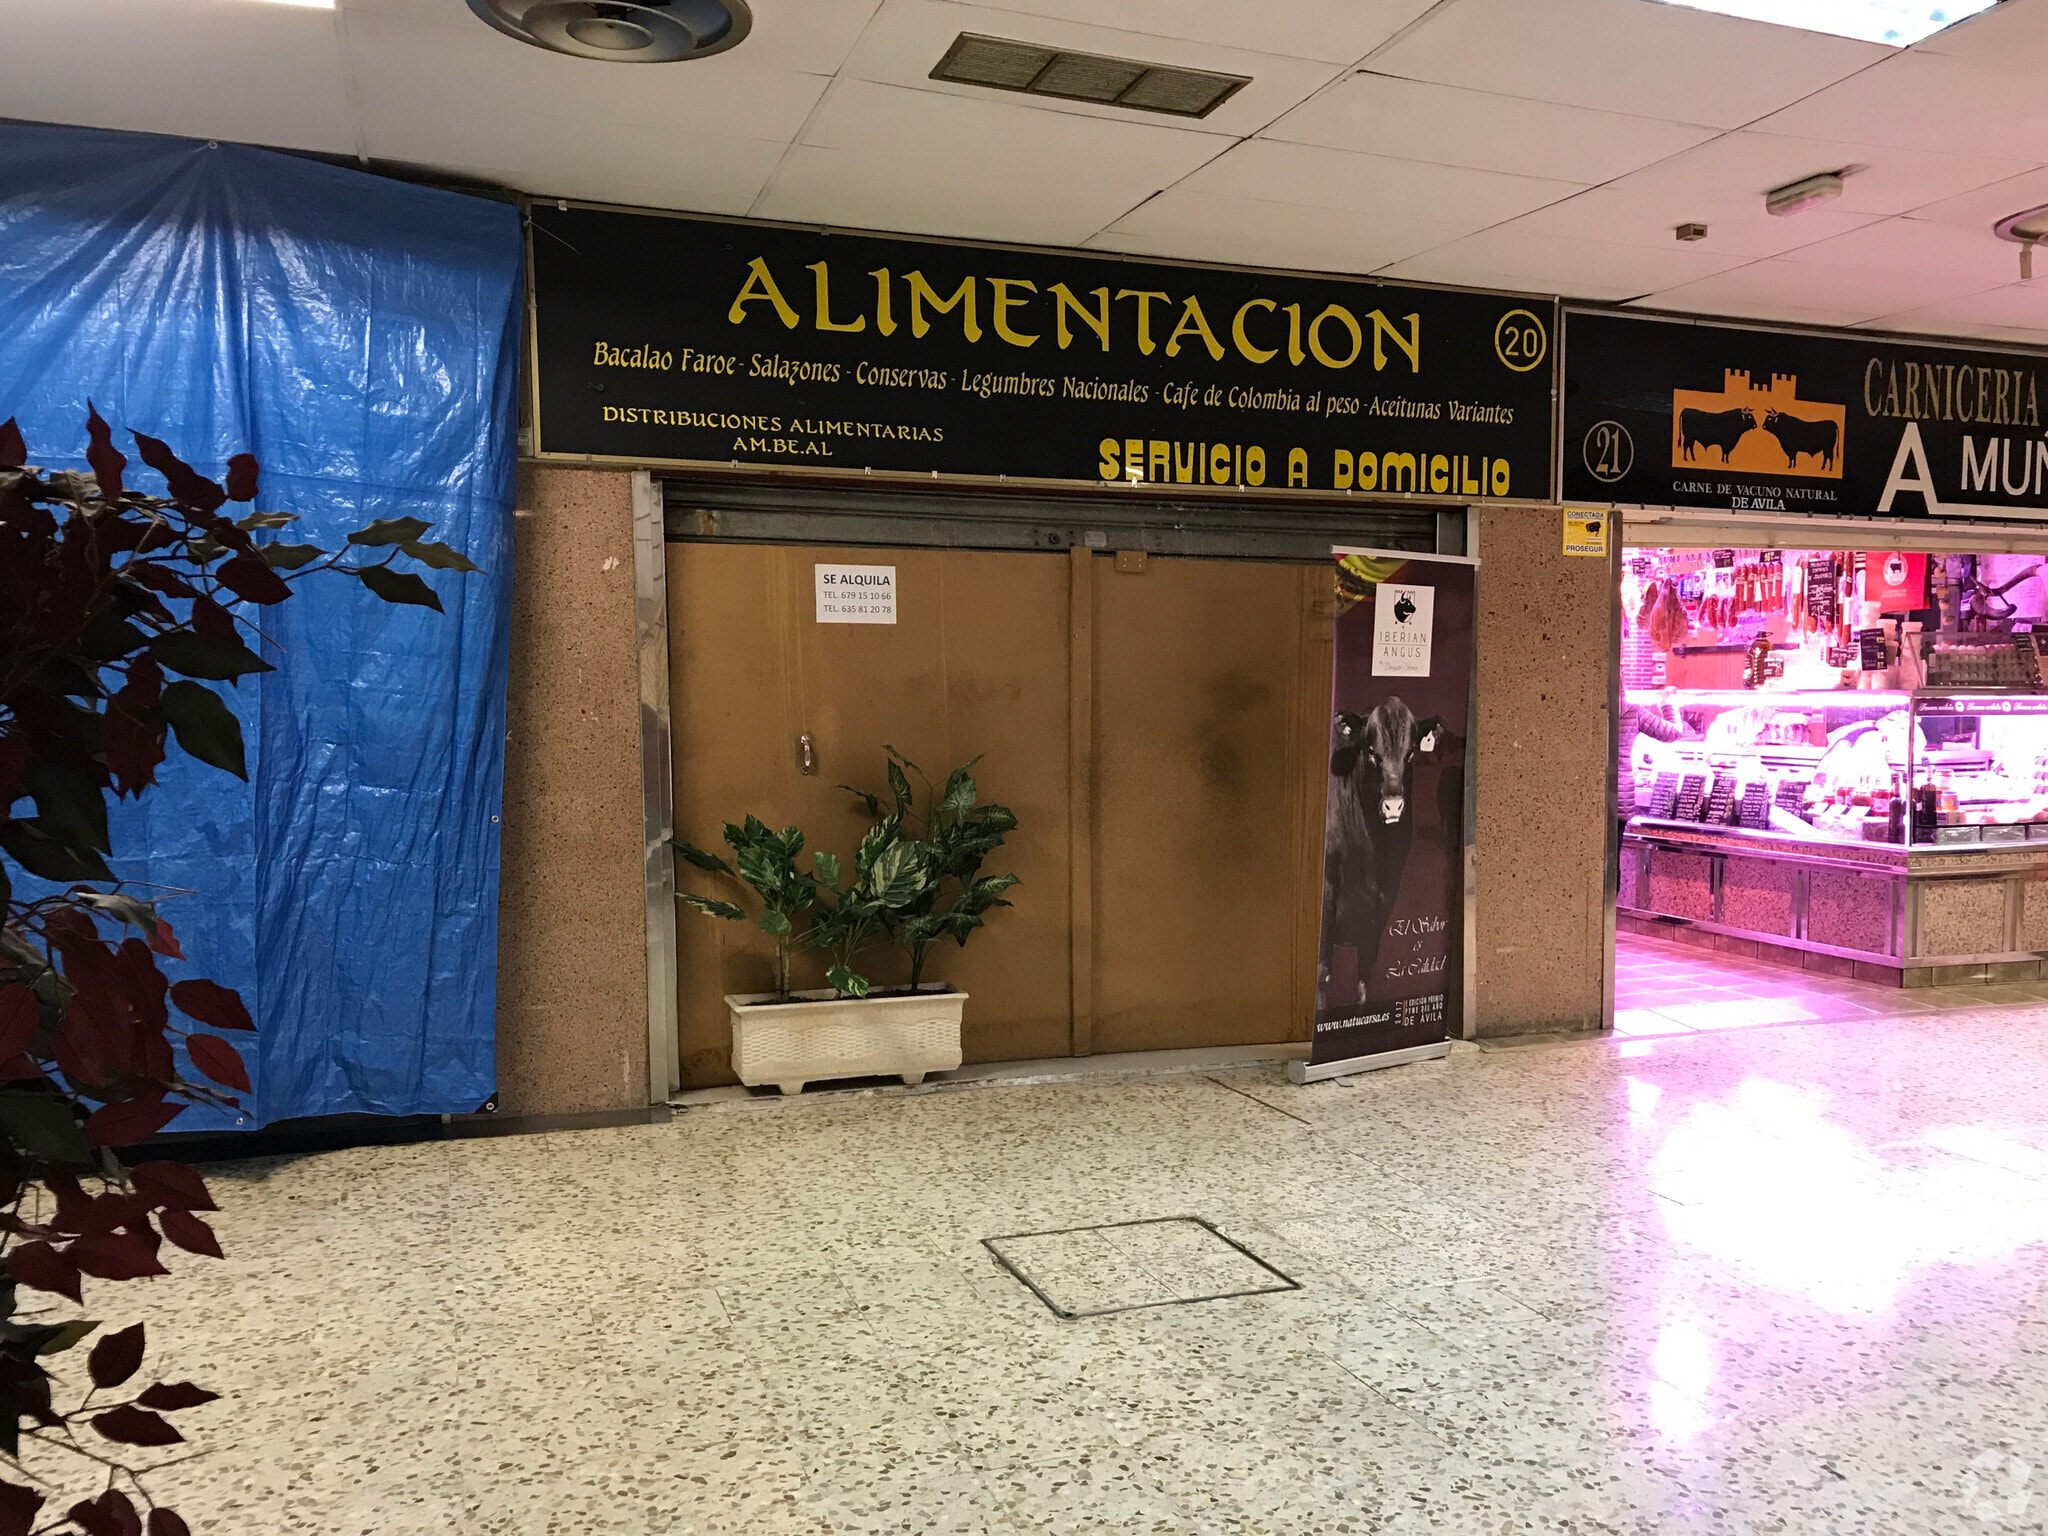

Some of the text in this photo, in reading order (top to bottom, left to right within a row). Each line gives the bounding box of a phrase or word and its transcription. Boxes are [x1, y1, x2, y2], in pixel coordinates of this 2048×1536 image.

[728, 256, 1420, 373] ALIMENTACION
[1503, 326, 1538, 359] 20
[594, 342, 672, 370] Bacalao
[682, 349, 736, 375] Faroe
[749, 354, 840, 385] Salazones
[857, 362, 946, 390] Conservas
[962, 369, 1055, 398] Legumbres
[1063, 377, 1148, 403] Nacionales
[1163, 382, 1199, 409] Cafe
[1204, 385, 1222, 407] de
[1228, 387, 1301, 411] Colombia
[1306, 391, 1321, 412] al
[1325, 397, 1359, 418] peso
[1369, 396, 1441, 420] Aceitunas
[1448, 400, 1514, 424] Variantes
[1864, 357, 2040, 427] CARNICERIA
[602, 406, 943, 442] DISTRIBUCIONES ALIMENTARIAS
[733, 437, 832, 456] AM.BE.AL
[1597, 430, 1622, 475] 21
[1099, 438, 1511, 496] SERVICIO A DOMICILIO
[1876, 421, 1940, 515] A
[1673, 481, 1838, 500] CARNE DE VACUNO NATURAL
[1731, 497, 1786, 510] DE AVILA
[1565, 545, 1604, 553] PROSEGUR
[823, 574, 891, 586] SE ALQUILA
[823, 591, 838, 599] TEL.
[841, 591, 856, 599] 679
[870, 592, 880, 600] 10
[841, 605, 857, 613] 635
[1379, 631, 1427, 644] IBERIAN
[1383, 646, 1422, 658] ANGUS
[1404, 1016, 1415, 1027] DE
